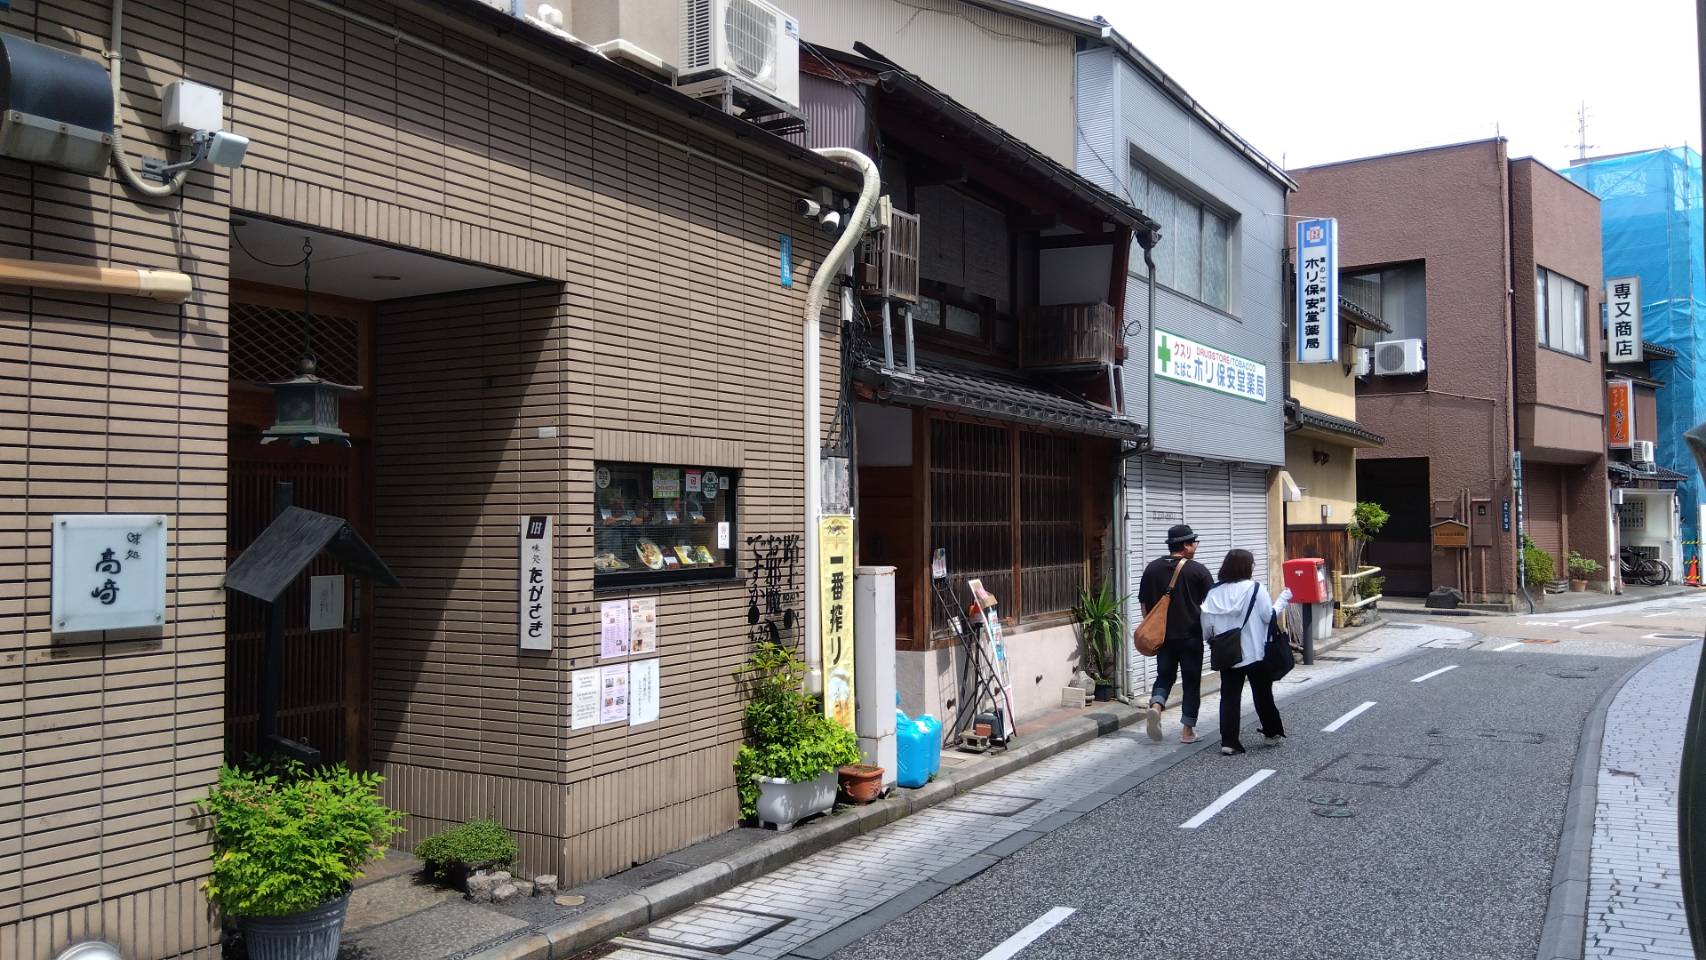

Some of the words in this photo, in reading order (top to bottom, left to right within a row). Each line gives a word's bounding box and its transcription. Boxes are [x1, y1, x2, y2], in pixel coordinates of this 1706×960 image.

[1305, 258, 1320, 349] ホリ保安堂薬局
[1613, 283, 1632, 356] 専又商店
[1174, 341, 1192, 360] クスリ
[1194, 357, 1265, 397] ホリ保安堂薬局
[125, 532, 142, 560] 味処
[528, 566, 544, 638] たかさき
[829, 556, 845, 666] 一番搾り
